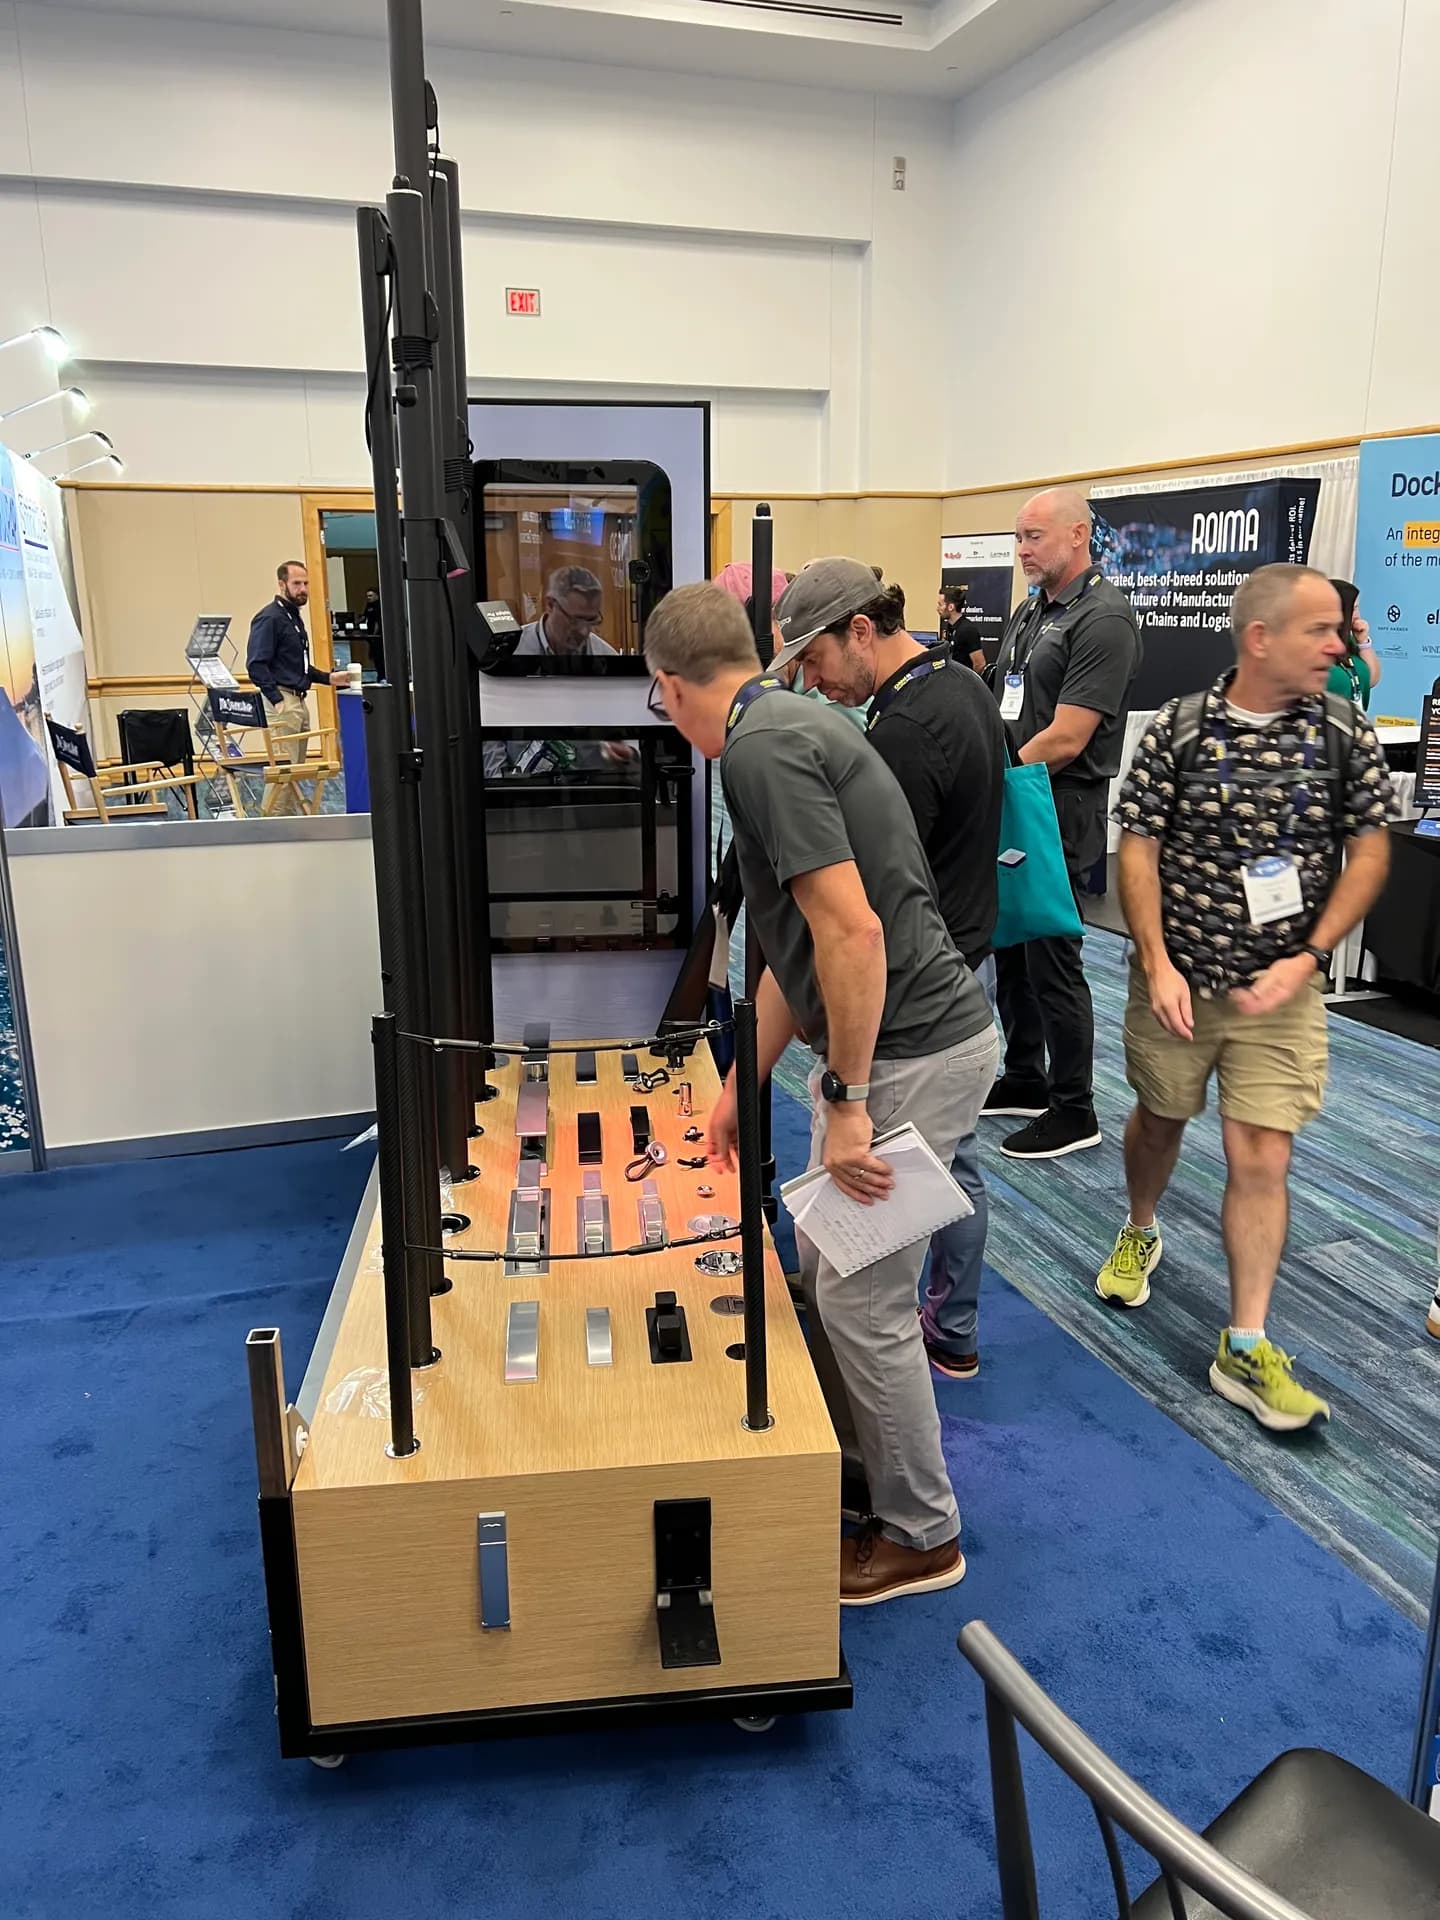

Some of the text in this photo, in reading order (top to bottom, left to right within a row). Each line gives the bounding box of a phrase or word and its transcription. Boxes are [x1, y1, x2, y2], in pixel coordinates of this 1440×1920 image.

[511, 292, 535, 312] EXIT
[1191, 508, 1260, 554] ROIMA
[1386, 527, 1403, 541] An
[1385, 552, 1398, 567] of
[1402, 553, 1422, 567] the
[1136, 569, 1204, 587] best-of-breed
[1130, 590, 1234, 607] future of Manufactur
[1146, 610, 1179, 627] Chains
[1180, 611, 1201, 628] and
[1202, 612, 1231, 633] Logis
